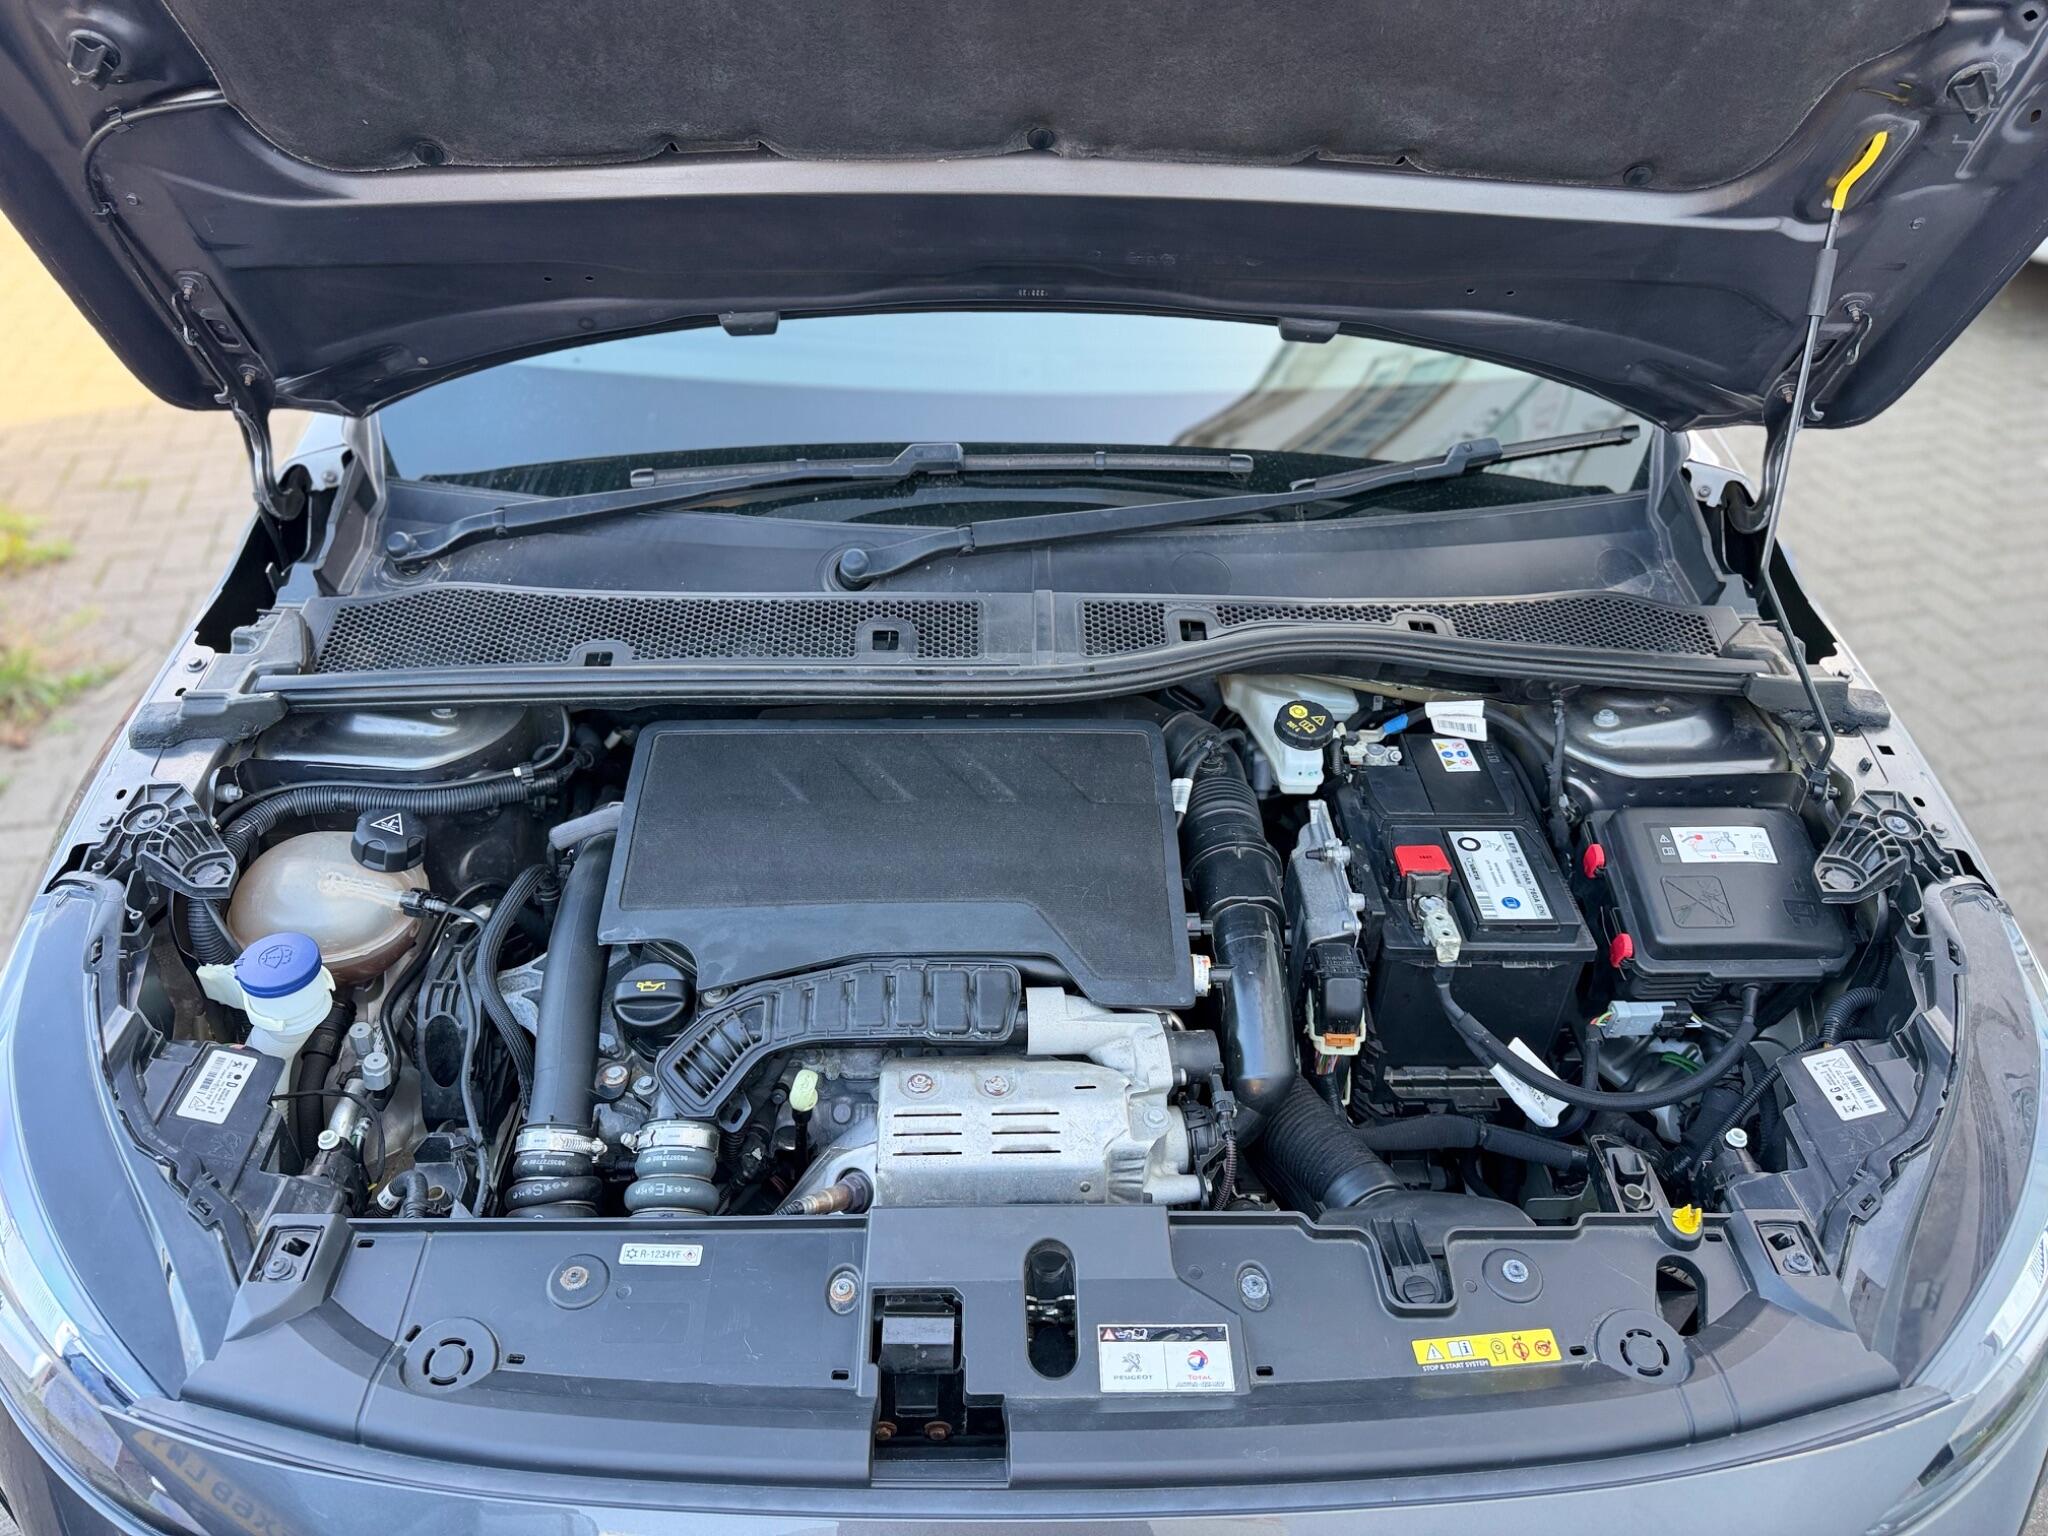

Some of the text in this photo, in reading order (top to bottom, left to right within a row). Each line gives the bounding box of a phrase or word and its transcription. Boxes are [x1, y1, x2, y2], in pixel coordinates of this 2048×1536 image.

[640, 1249, 681, 1259] R-1234YF
[1422, 1364, 1439, 1372] STOP
[1445, 1361, 1464, 1369] START
[1465, 1359, 1489, 1368] SYSTEM
